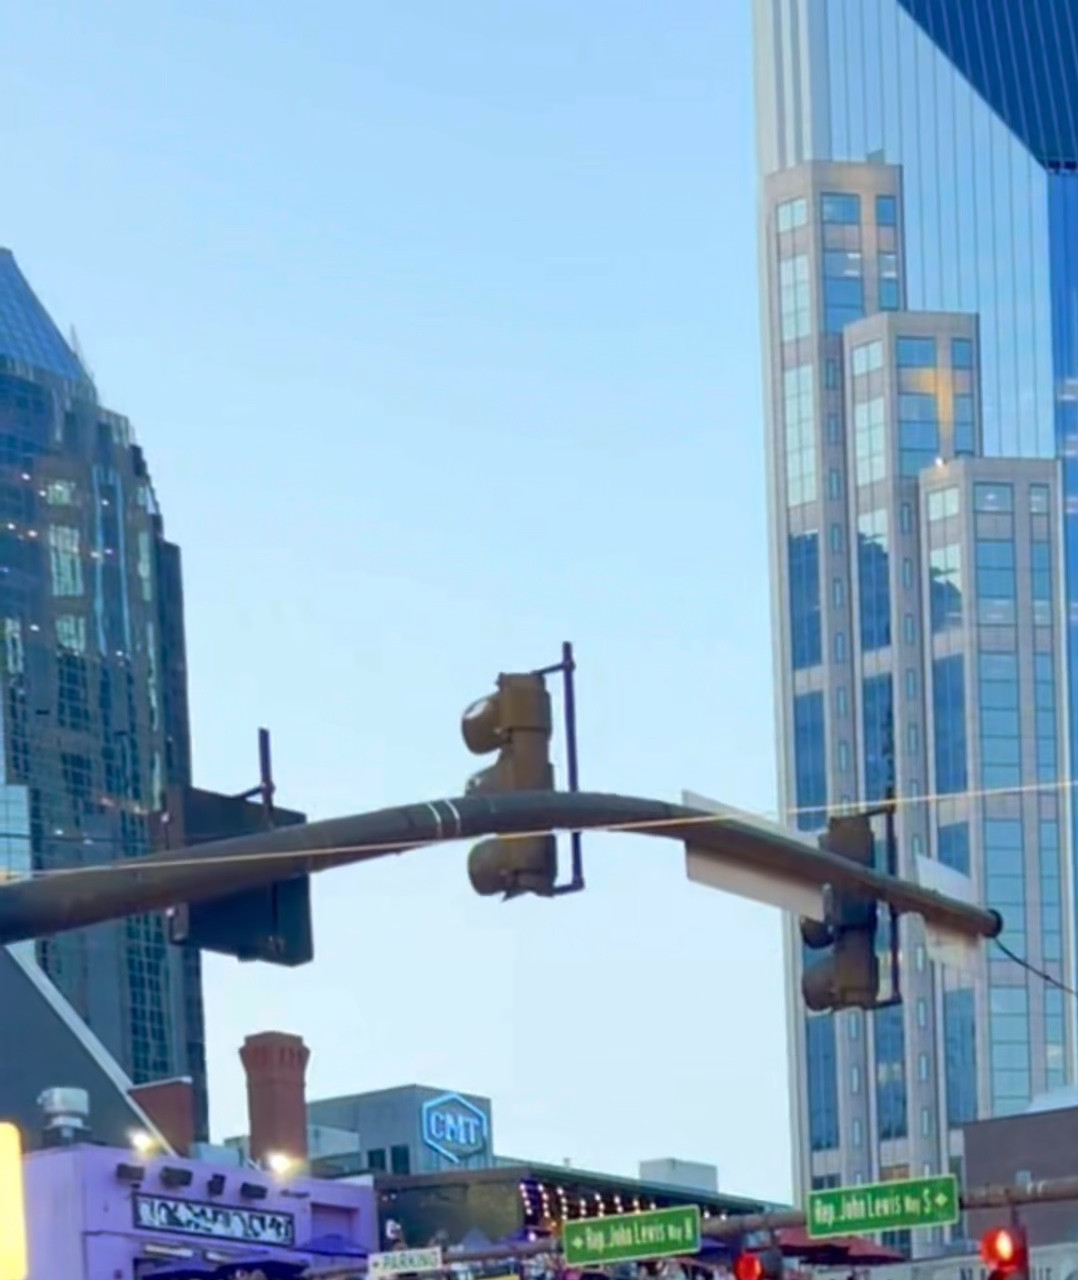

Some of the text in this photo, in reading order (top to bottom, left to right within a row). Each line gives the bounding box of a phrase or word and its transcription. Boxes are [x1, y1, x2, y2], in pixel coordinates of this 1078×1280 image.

[429, 1110, 481, 1145] CMT
[839, 1194, 866, 1220] John
[867, 1192, 901, 1217] Lewis
[922, 1188, 931, 1213] S
[609, 1221, 633, 1247] John
[634, 1219, 665, 1244] Lewis
